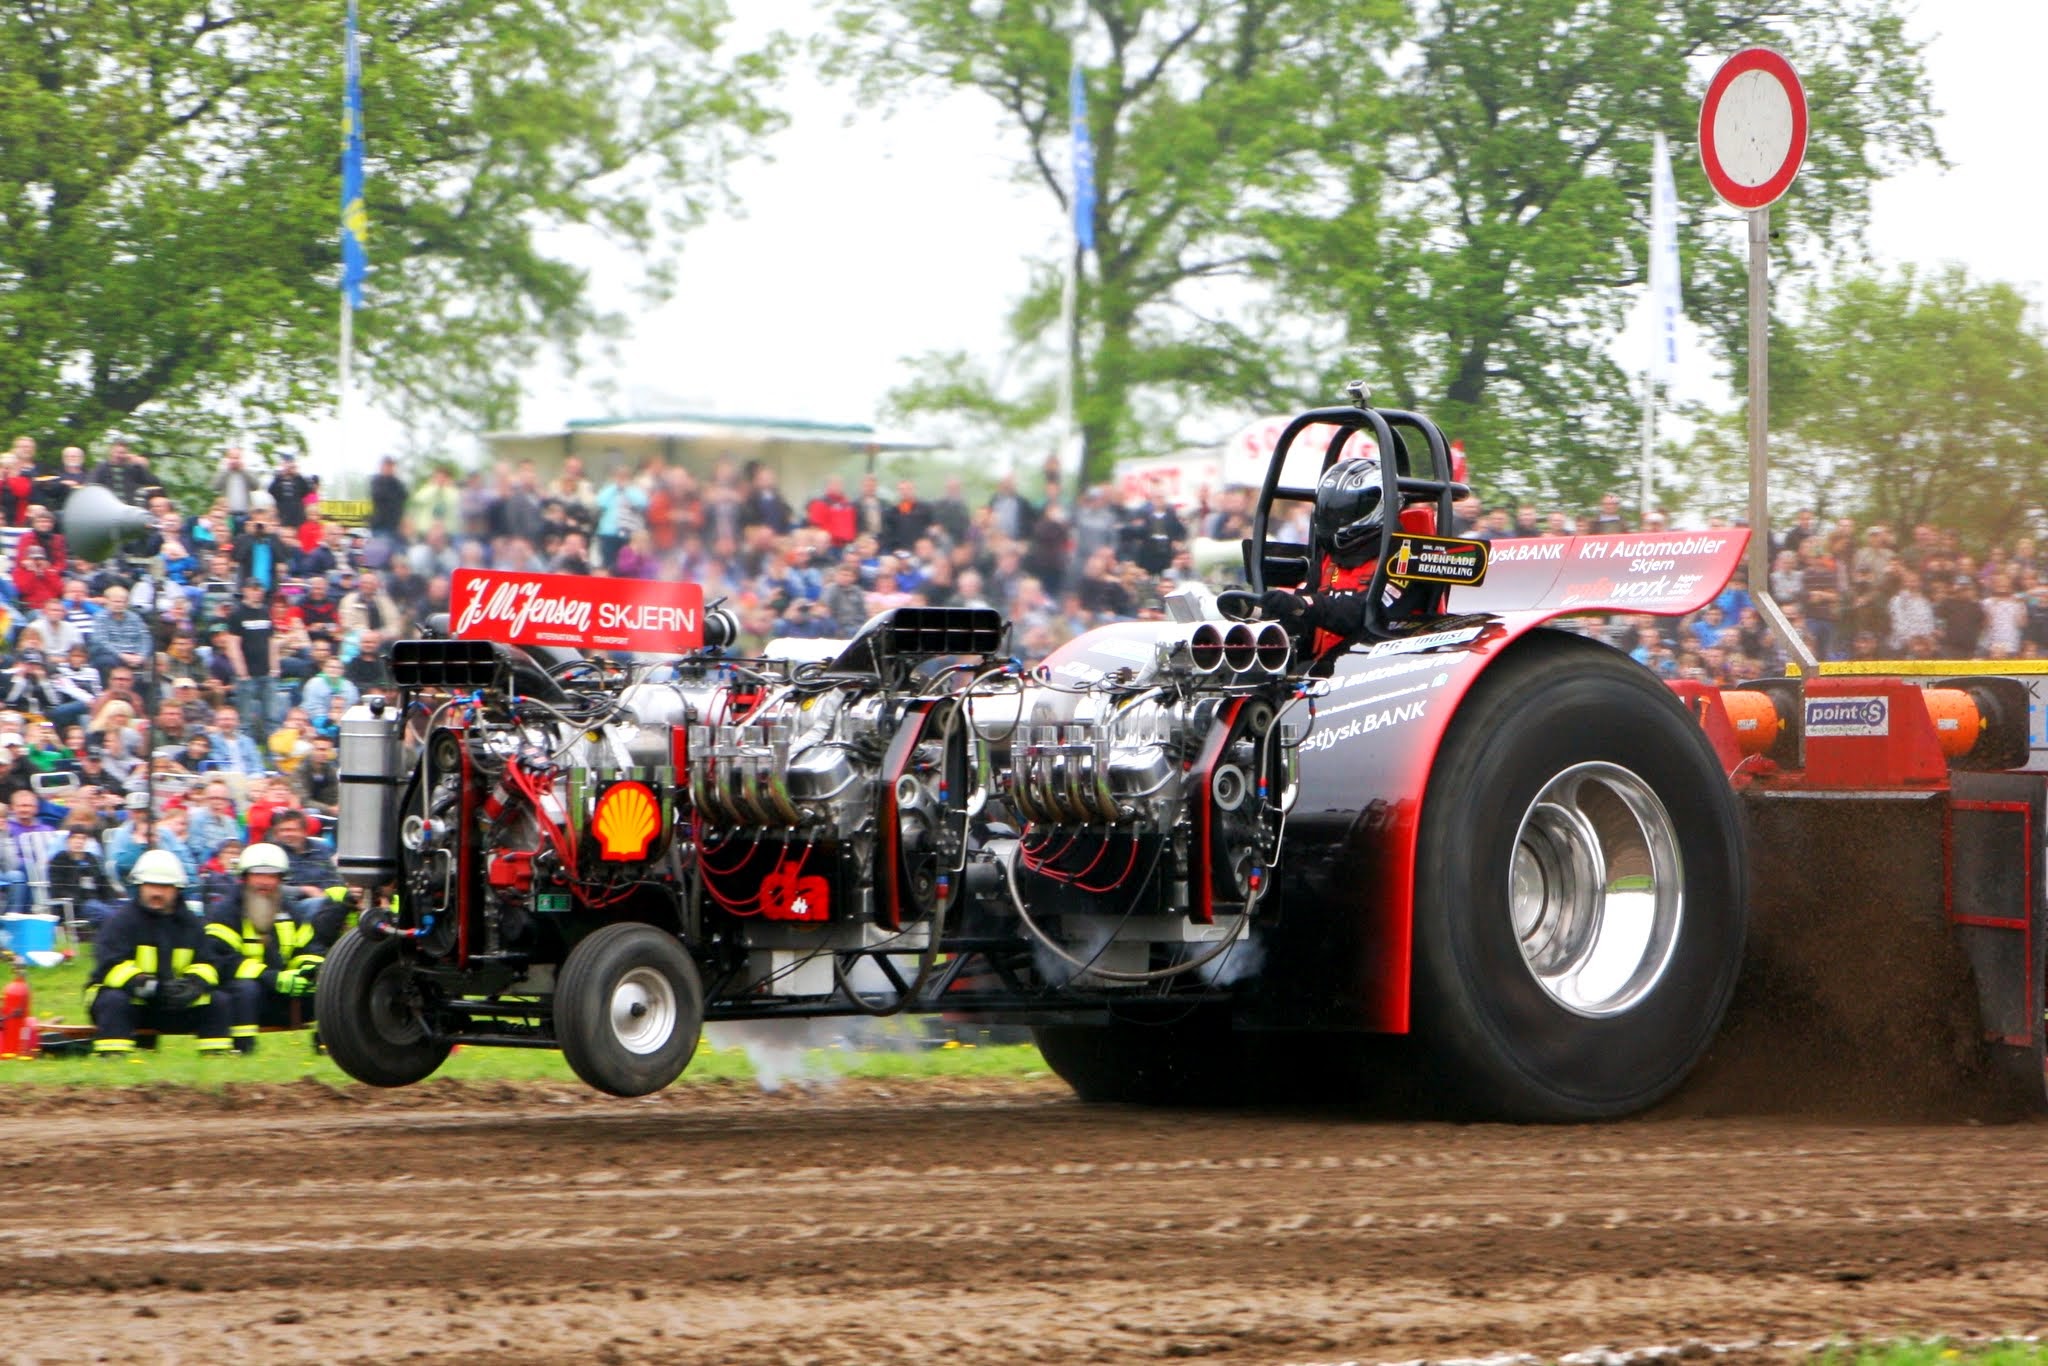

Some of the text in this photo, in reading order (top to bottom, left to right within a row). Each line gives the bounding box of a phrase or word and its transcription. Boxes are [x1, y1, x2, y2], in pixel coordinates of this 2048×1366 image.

[1488, 543, 1564, 565] jyskBANK
[1579, 537, 1726, 560] KH Automobiler
[1418, 563, 1473, 577] BEHANDLING
[1420, 552, 1477, 567] OVERFLADE
[1628, 557, 1675, 574] Skjern
[599, 602, 696, 633] SKJERN
[1811, 704, 1859, 724] point
[1298, 699, 1427, 753] estjyskBANK
